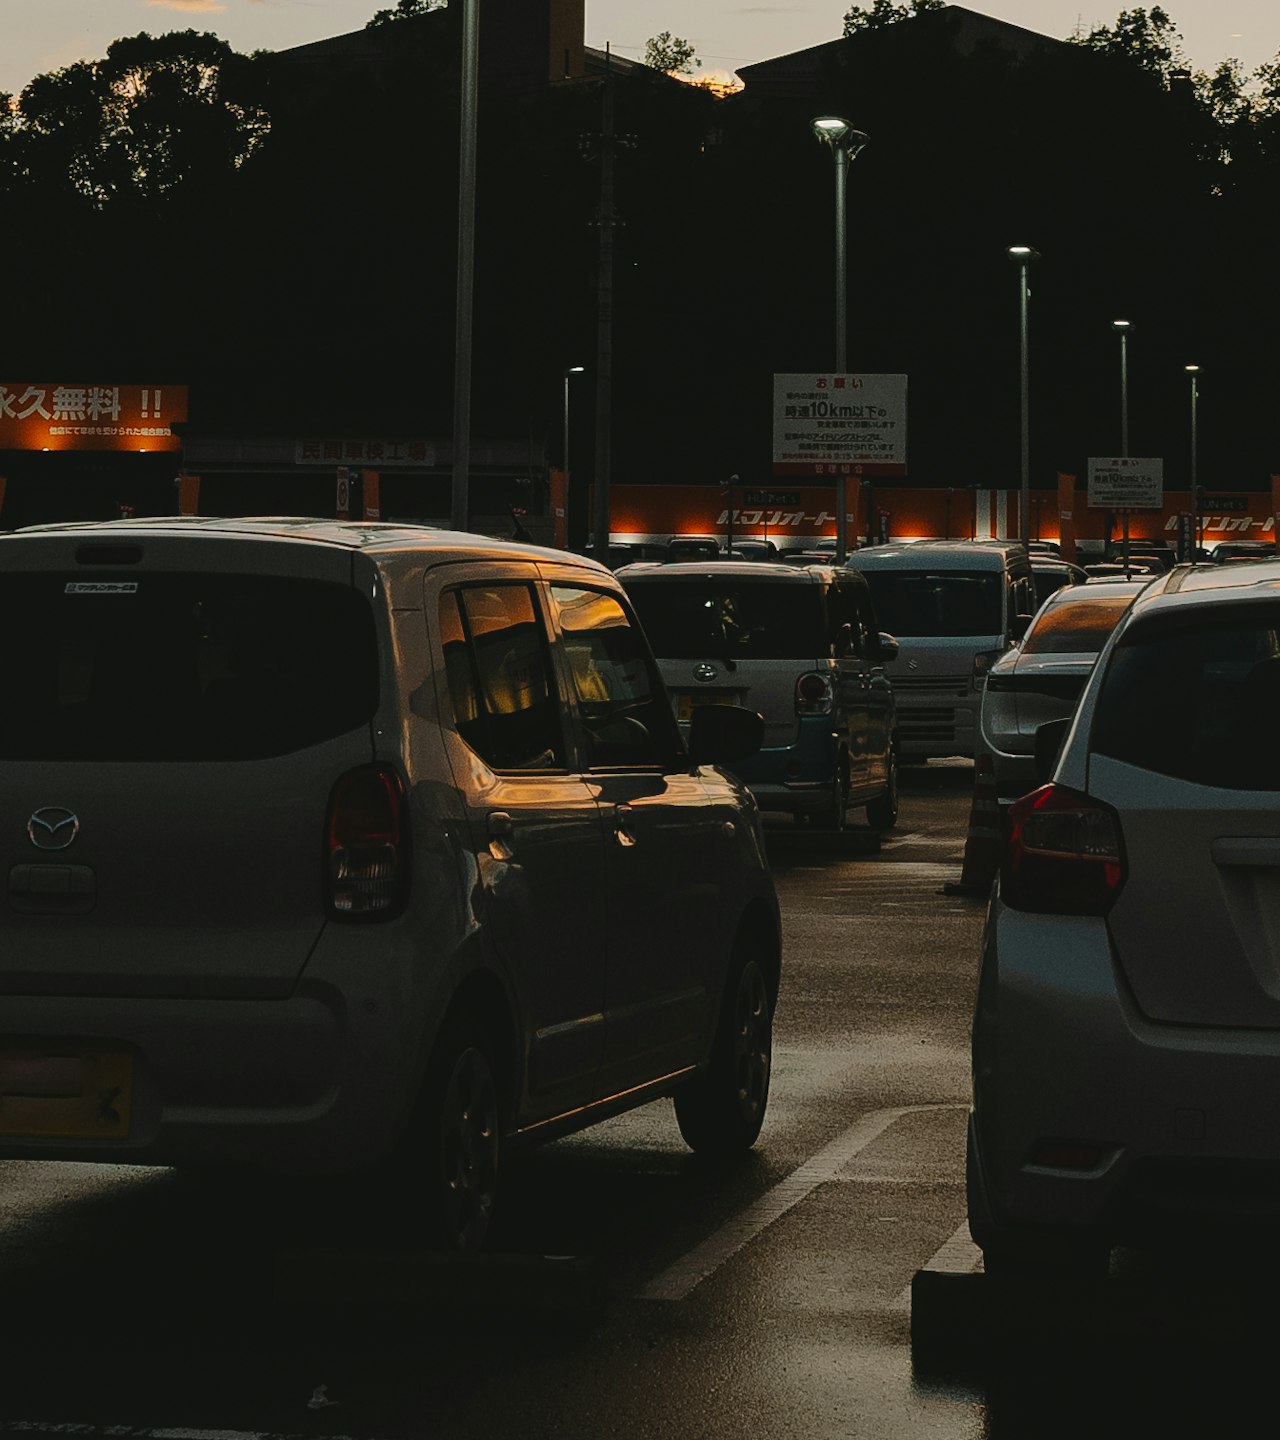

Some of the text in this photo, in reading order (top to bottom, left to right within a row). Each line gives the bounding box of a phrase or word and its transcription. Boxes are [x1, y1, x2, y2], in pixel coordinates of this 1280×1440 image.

[816, 378, 863, 389] お願い
[785, 402, 887, 418] 時速10km以下の
[303, 441, 426, 460] 民間車検工場
